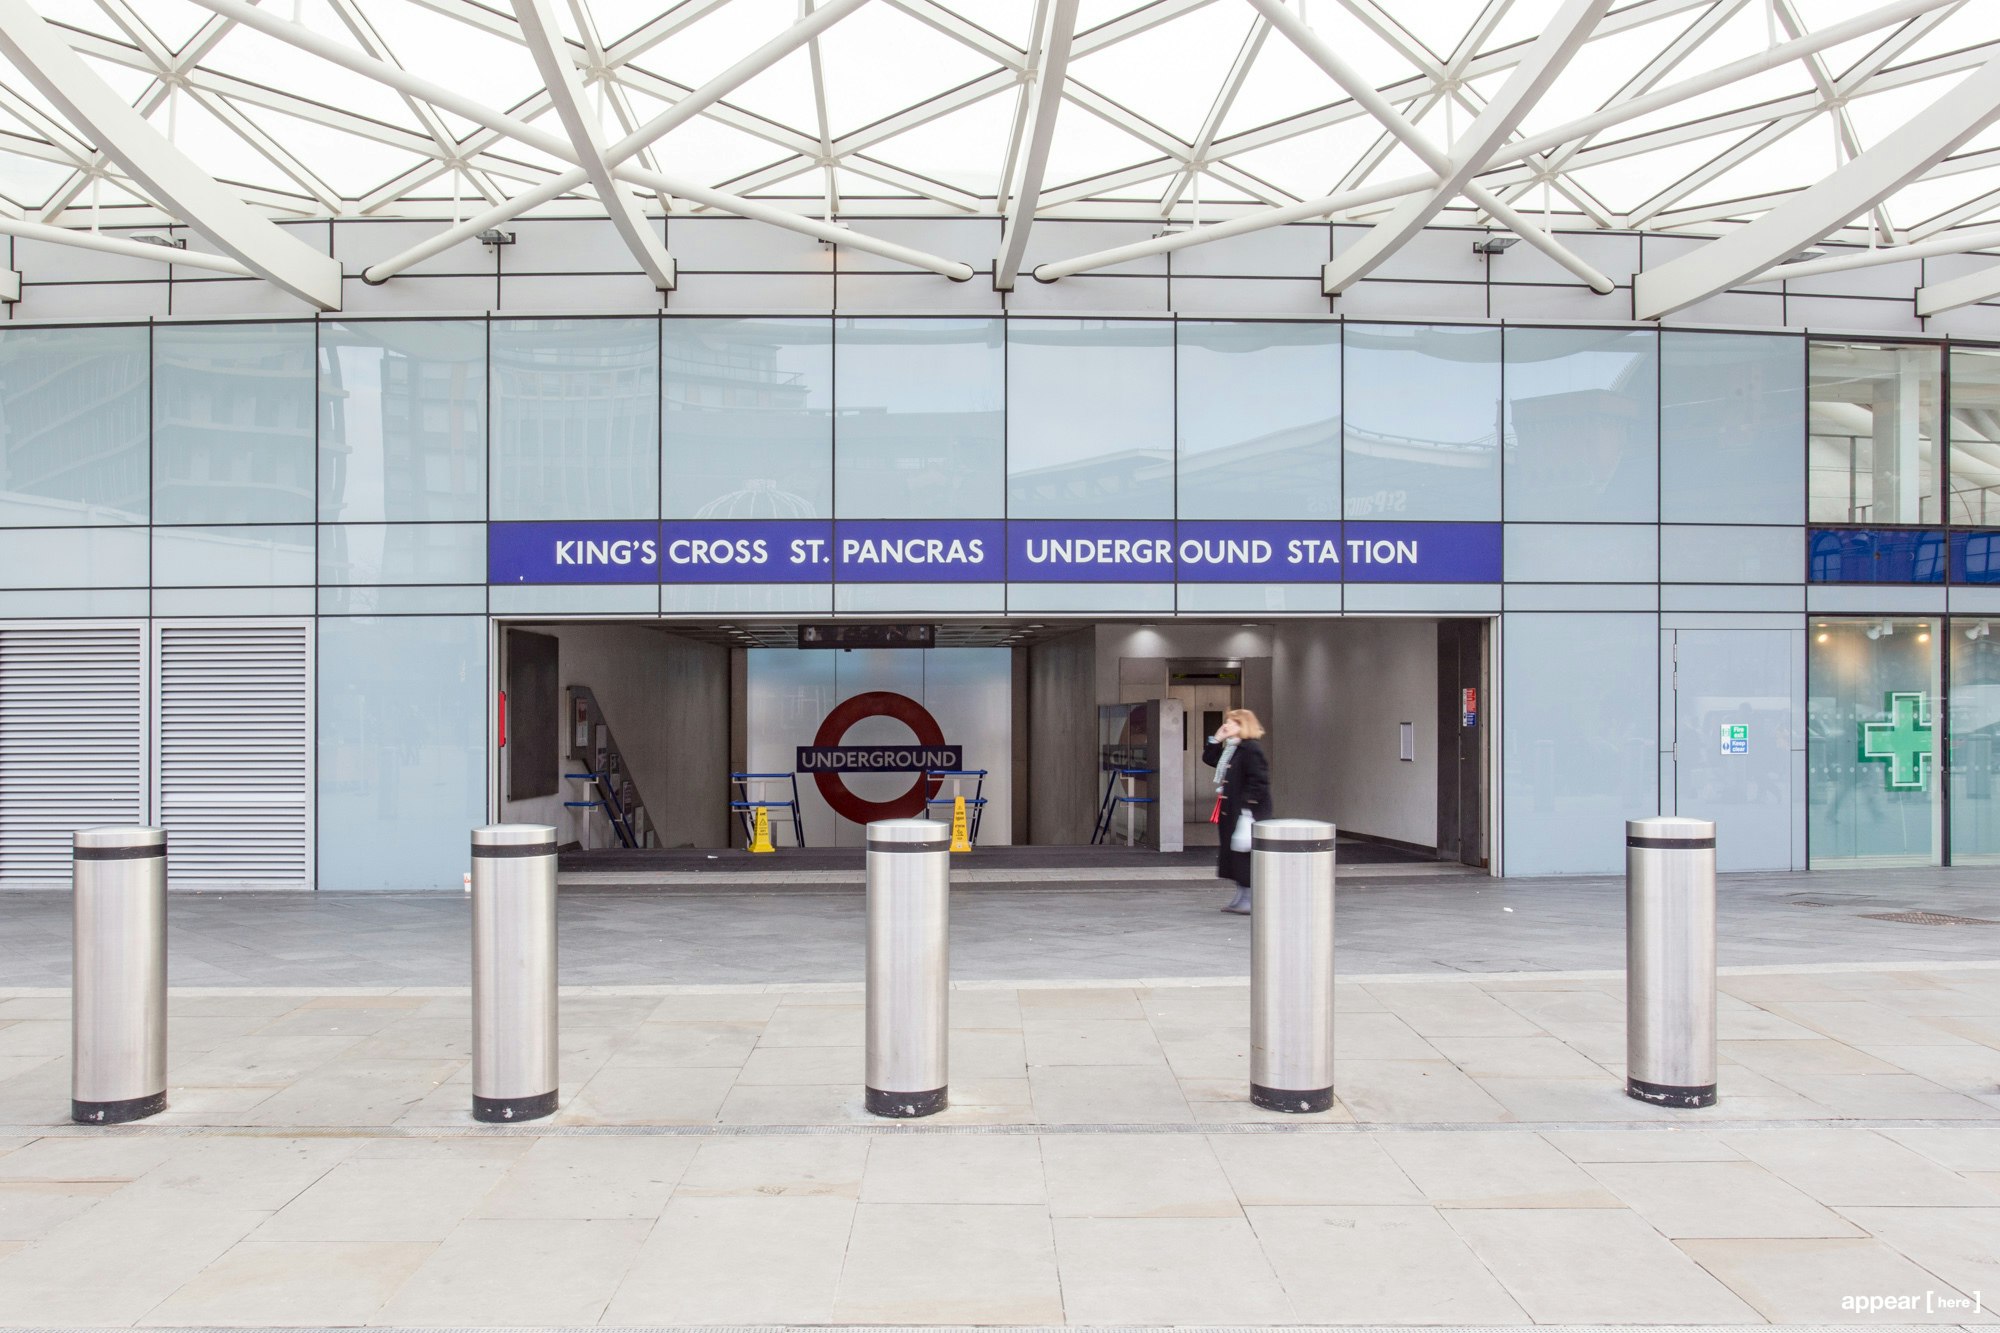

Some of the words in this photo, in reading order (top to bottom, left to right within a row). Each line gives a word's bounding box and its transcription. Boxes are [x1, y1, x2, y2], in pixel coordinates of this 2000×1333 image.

[556, 539, 657, 565] KING'S
[669, 539, 768, 564] CROSS
[789, 539, 830, 564] ST.
[842, 538, 984, 564] PANCRAS
[1026, 539, 1273, 564] UNDERGROUND
[1287, 539, 1418, 564] STATION
[802, 750, 956, 768] UNDERGROUND
